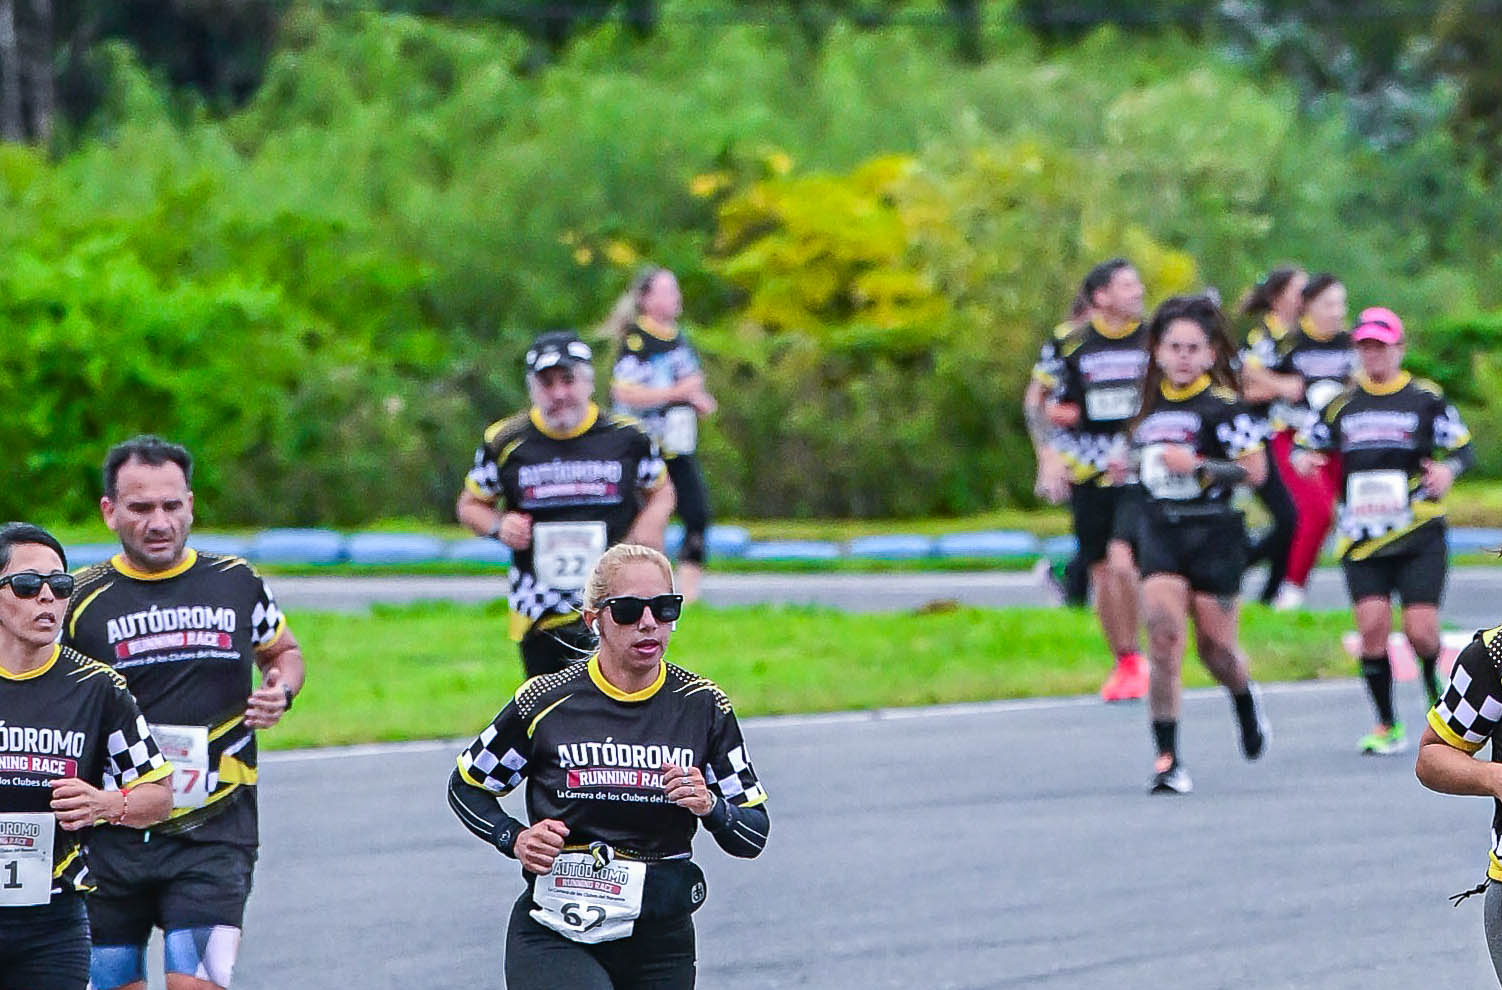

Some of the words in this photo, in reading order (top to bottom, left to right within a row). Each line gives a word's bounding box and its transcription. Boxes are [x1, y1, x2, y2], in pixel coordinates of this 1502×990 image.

[107, 605, 236, 644] AUTÓDROMO
[0, 720, 85, 758] ÓDROMO
[557, 736, 694, 769] AUTÓDROMO
[0, 756, 28, 771] NING
[32, 758, 66, 775] RACE
[13, 777, 40, 787] Clubes
[579, 770, 637, 786] RUNNING
[641, 772, 666, 788] RAC
[557, 790, 564, 798] La
[565, 791, 594, 800] Carrera
[595, 791, 606, 800] de
[607, 792, 620, 801] los
[621, 792, 648, 803] Clubes
[650, 794, 663, 803] del
[0, 821, 40, 838] DROMO
[561, 903, 606, 932] 62
